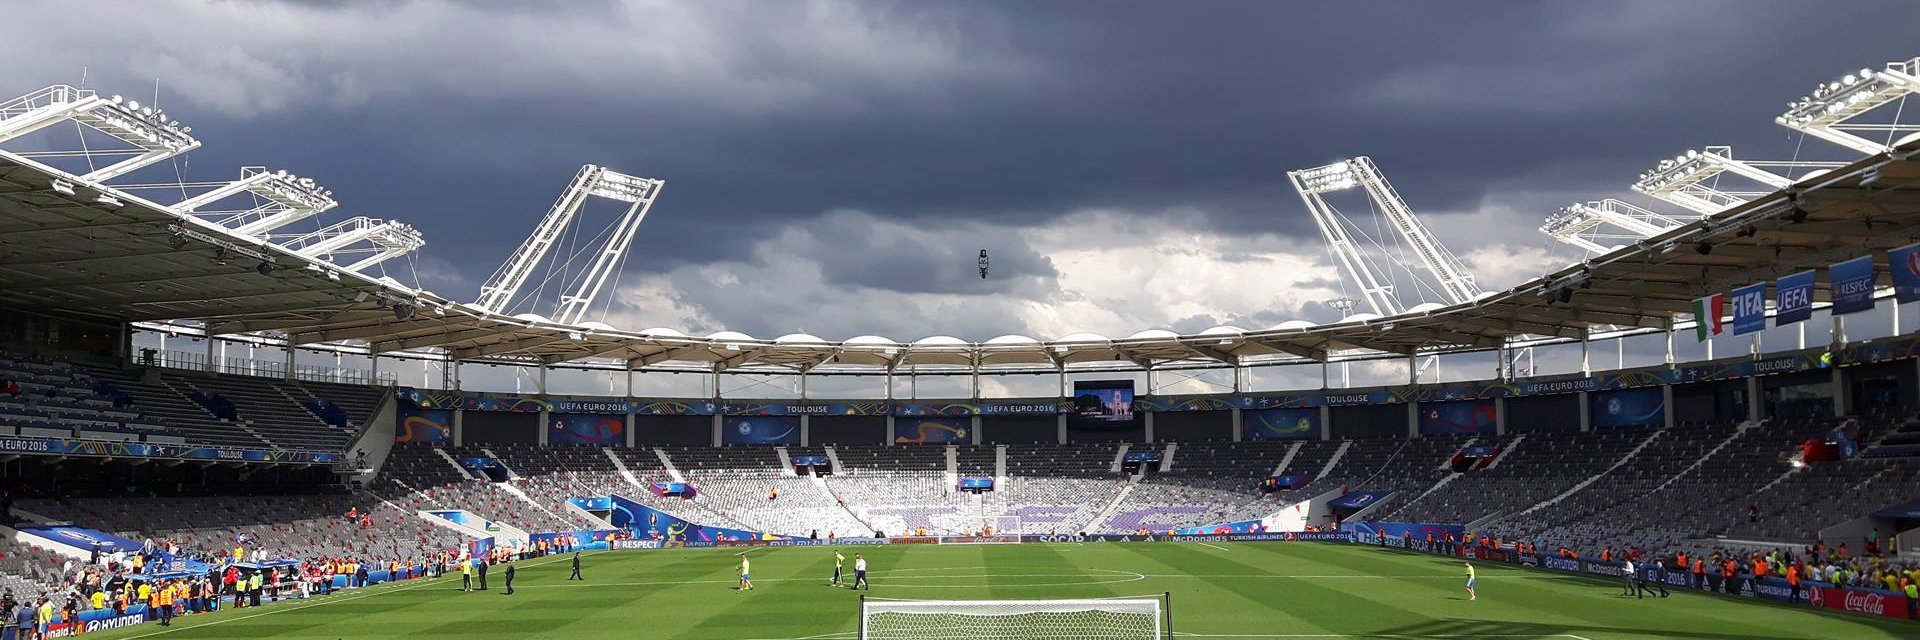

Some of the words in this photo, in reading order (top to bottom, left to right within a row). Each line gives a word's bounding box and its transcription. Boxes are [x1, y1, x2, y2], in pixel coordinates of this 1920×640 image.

[1731, 290, 1764, 319] FIFA
[1776, 287, 1808, 311] UEFA
[1527, 383, 1549, 392] UEFA
[1550, 382, 1573, 391] EURO
[1574, 380, 1595, 389] 2016
[1326, 394, 1368, 403] TOULOUSE
[560, 402, 582, 410] UEFA
[583, 403, 606, 411] EURO
[607, 403, 628, 411] 2016
[787, 405, 828, 413] TOULOUSE
[1034, 404, 1054, 412] 2016
[5, 439, 28, 450] EURO
[28, 441, 48, 451] 2016
[217, 450, 243, 459] TOULOUSE
[1172, 534, 1228, 542] McDonald's
[1364, 532, 1404, 547] Hisnse
[622, 540, 658, 549] RESPECT
[1410, 538, 1430, 551] SOCAR
[1553, 558, 1579, 571] HYUNDAI
[1667, 571, 1686, 586] 2016
[1757, 584, 1782, 596] TURKISH
[101, 614, 144, 630] HYUNDAI
